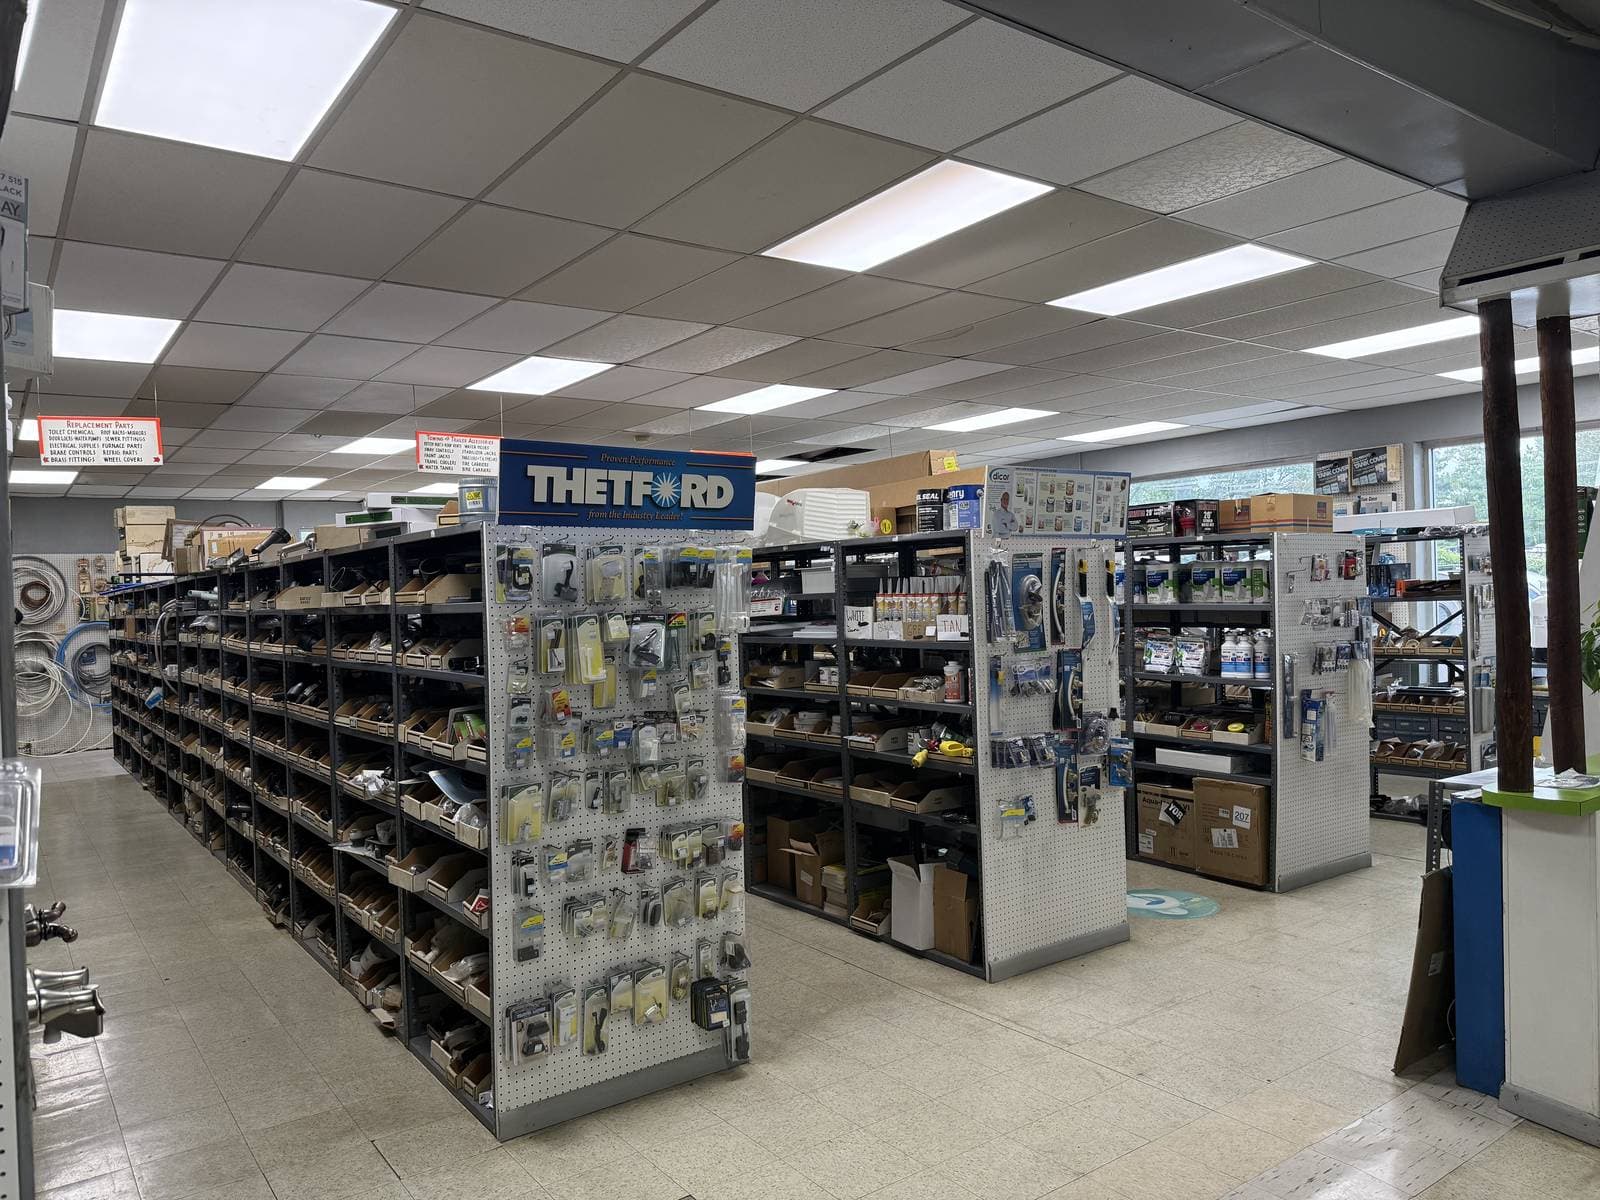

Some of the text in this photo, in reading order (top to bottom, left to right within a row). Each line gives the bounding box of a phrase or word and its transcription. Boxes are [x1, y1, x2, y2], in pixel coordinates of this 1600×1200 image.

[600, 453, 676, 467] Proven Performance
[993, 471, 1009, 480] dicor
[527, 464, 734, 509] THETFORD
[587, 510, 609, 521] from
[609, 510, 621, 519] the
[623, 511, 654, 521] Industry
[846, 610, 864, 621] WHITE
[942, 617, 962, 632] TAN
[1234, 811, 1250, 821] 207
